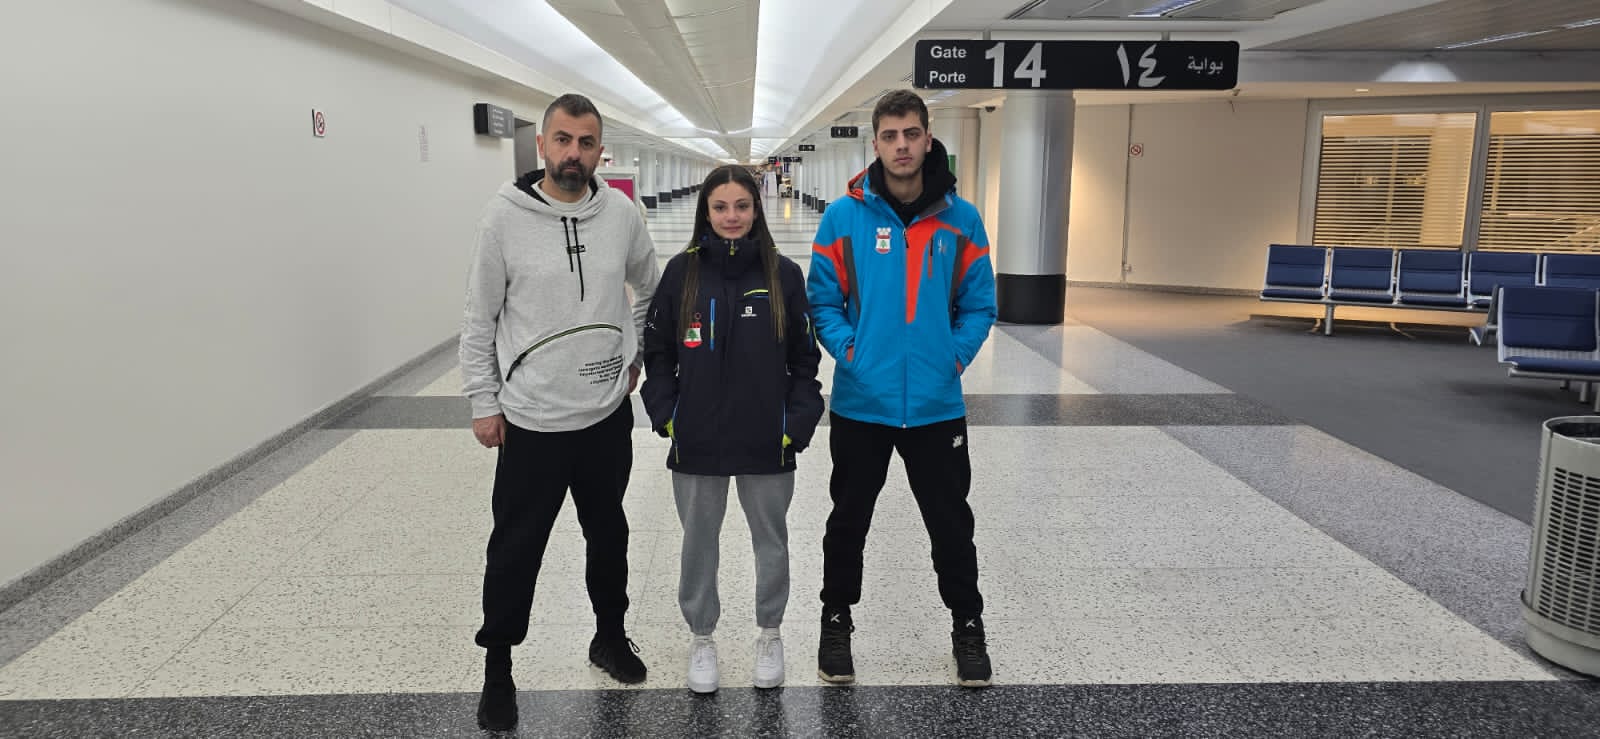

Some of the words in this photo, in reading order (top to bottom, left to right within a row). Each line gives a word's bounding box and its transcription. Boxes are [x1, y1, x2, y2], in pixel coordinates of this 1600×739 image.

[930, 45, 967, 59] Gate
[984, 42, 1047, 88] 14
[1116, 43, 1166, 88] ١٤
[1187, 55, 1224, 75] بوابة
[929, 70, 966, 83] Porte
